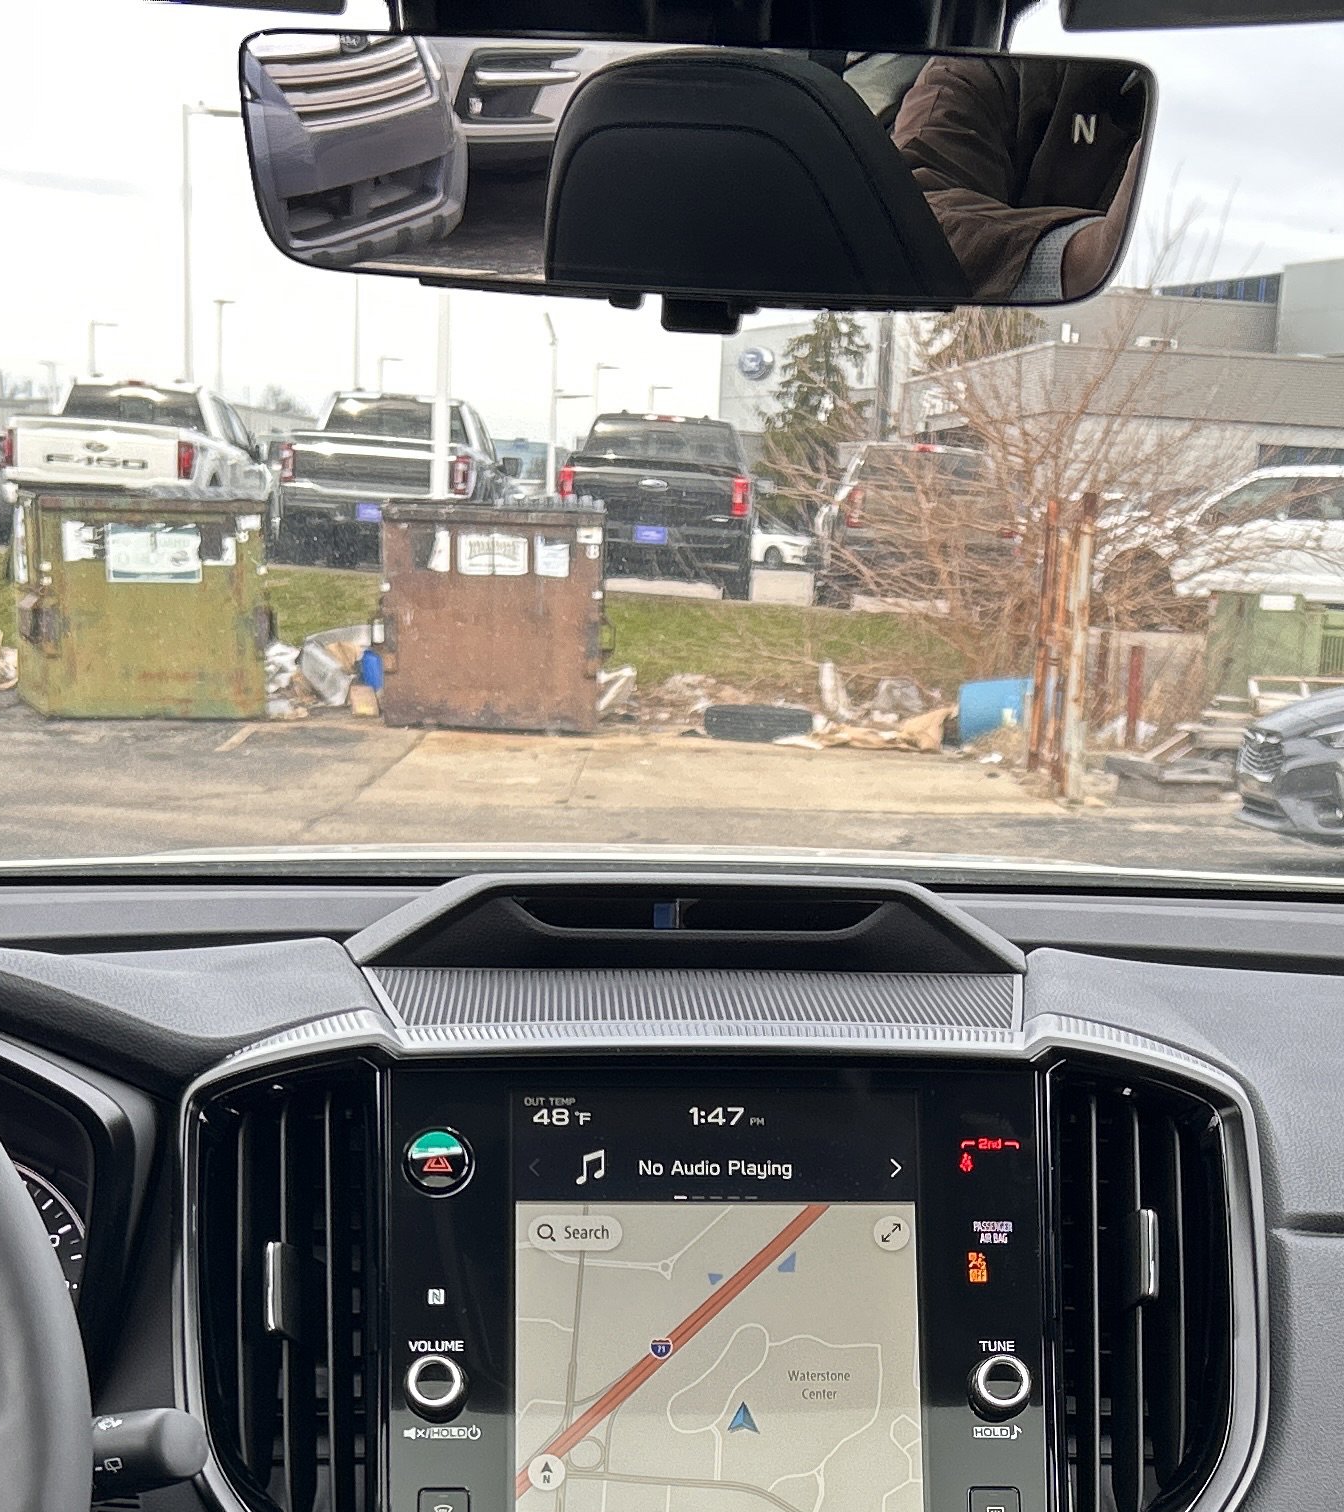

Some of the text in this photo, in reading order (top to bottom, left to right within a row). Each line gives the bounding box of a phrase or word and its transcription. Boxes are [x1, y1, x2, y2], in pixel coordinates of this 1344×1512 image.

[1073, 114, 1096, 144] N
[524, 1097, 576, 1106] OUT TEMP
[532, 1108, 569, 1126] 48
[688, 1106, 765, 1126] 1:47 PM
[978, 1138, 1002, 1149] 2nd
[638, 1159, 792, 1180] No Audio Playing
[564, 1225, 609, 1240] Search
[973, 1221, 1013, 1232] PASSENGER
[408, 1340, 465, 1352] VOLUME
[979, 1341, 1016, 1352] TUNE
[787, 1370, 851, 1382] Waterstone
[801, 1388, 838, 1400] Center
[974, 1427, 1010, 1438] HOLD
[542, 1475, 551, 1484] N
